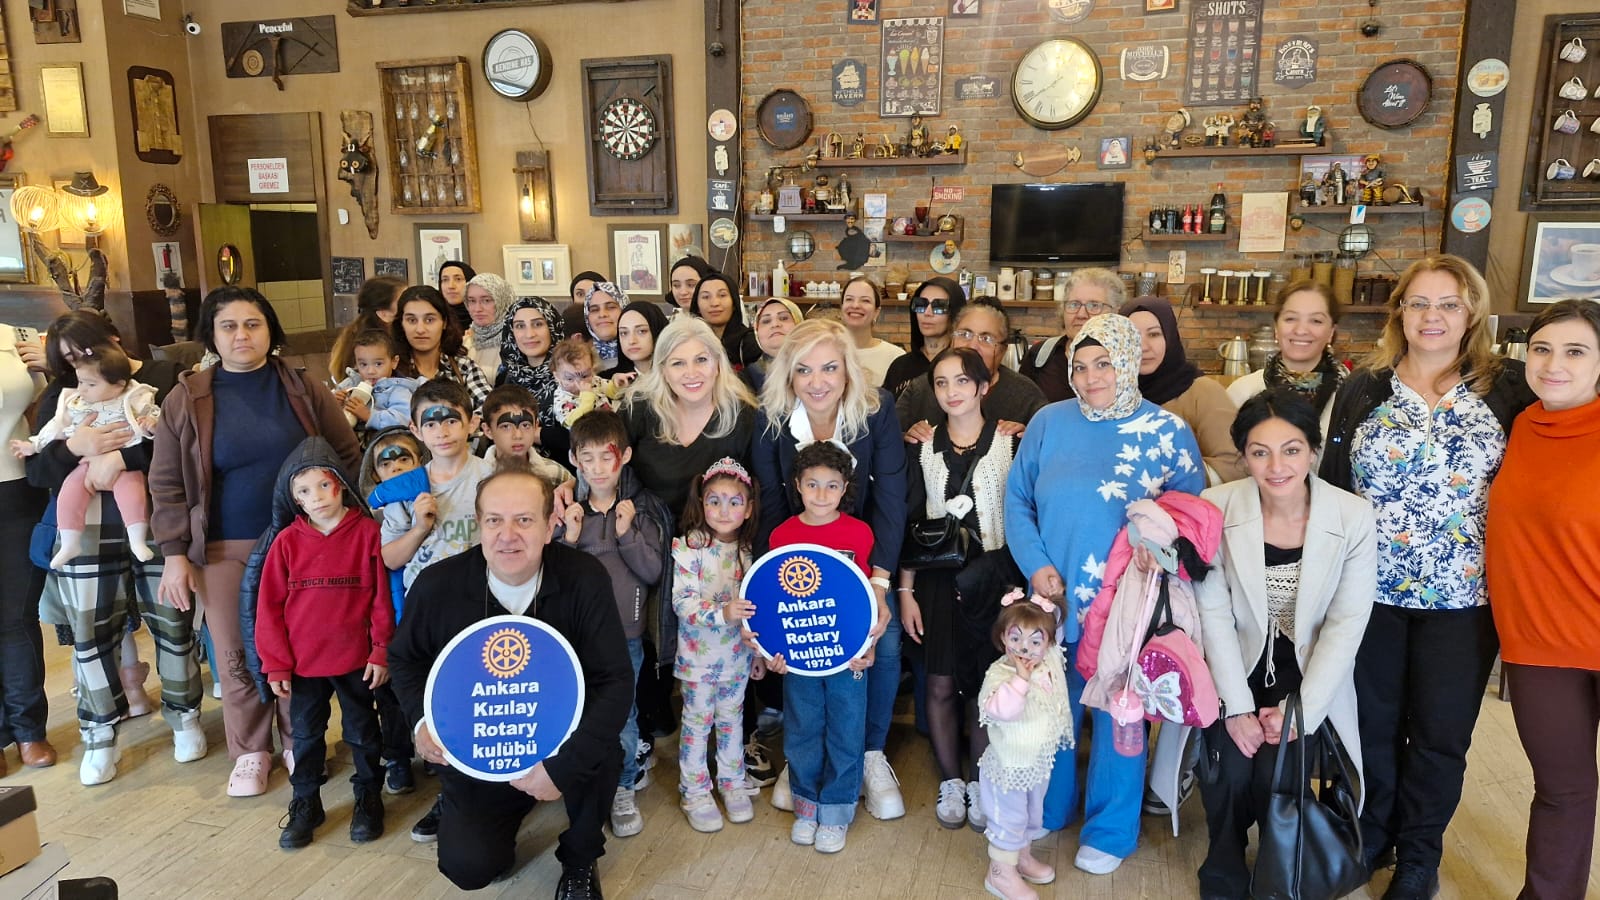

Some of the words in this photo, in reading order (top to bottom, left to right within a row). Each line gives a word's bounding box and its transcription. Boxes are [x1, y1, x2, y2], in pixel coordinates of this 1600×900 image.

[1207, 0, 1246, 16] SHOTS
[258, 22, 293, 34] Peaceful
[934, 191, 962, 200] SMOKING
[777, 597, 836, 614] Ankara
[781, 613, 837, 629] Kızılay
[785, 630, 840, 645] Rotary
[789, 644, 845, 660] kulübü
[804, 659, 832, 668] 1974
[471, 681, 539, 697] Ankara
[473, 700, 539, 717] Kızılay
[473, 721, 538, 738] Rotary
[472, 740, 538, 759] kulübü
[488, 758, 520, 770] 1974
